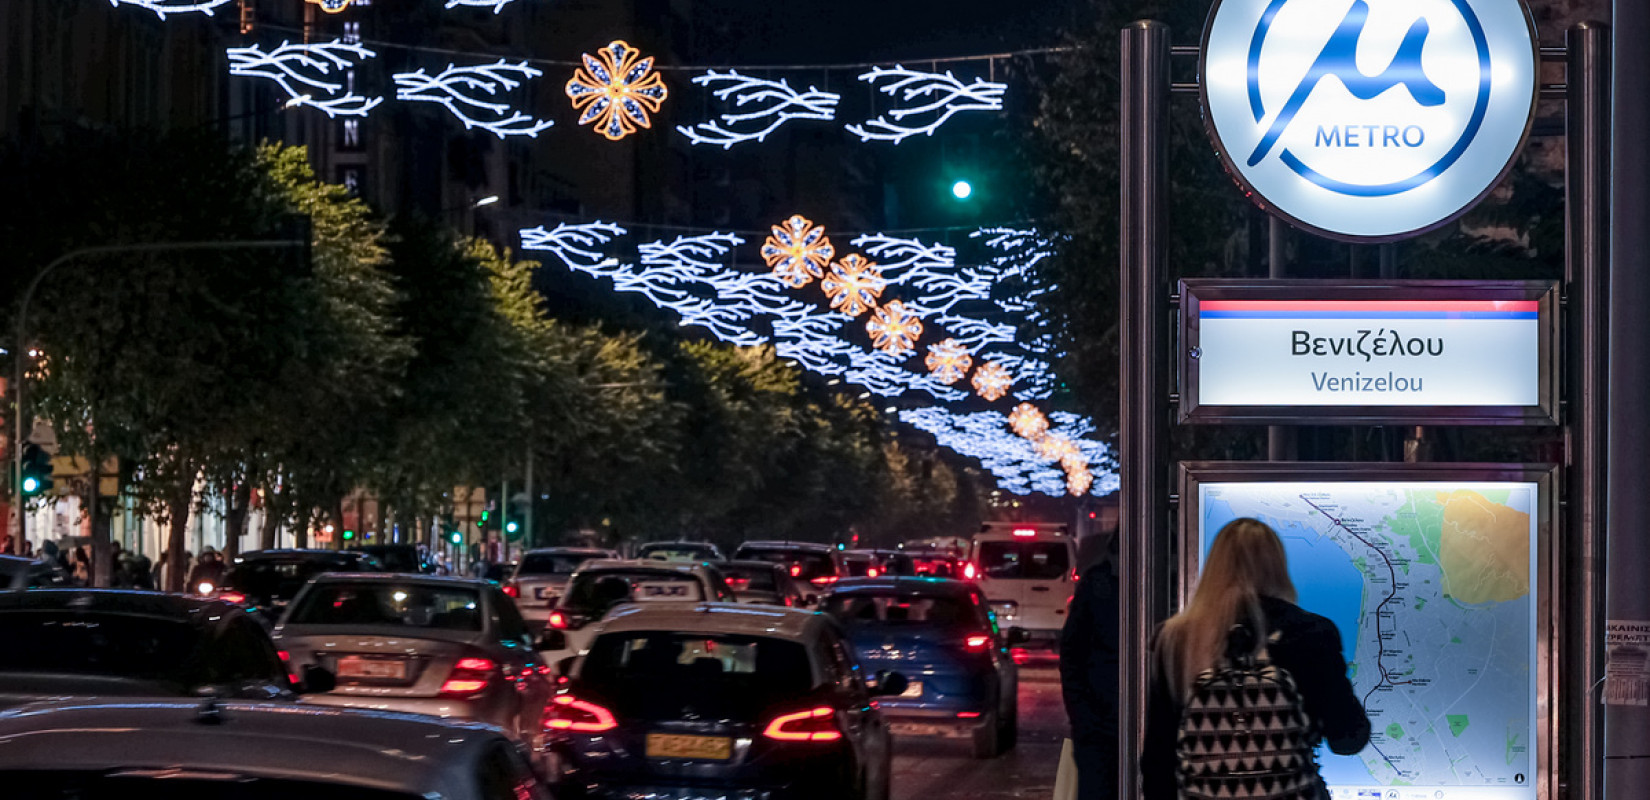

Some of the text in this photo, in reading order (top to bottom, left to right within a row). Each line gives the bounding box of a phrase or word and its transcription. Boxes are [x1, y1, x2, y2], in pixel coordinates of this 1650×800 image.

[1314, 126, 1425, 148] METRO
[1291, 329, 1444, 363] Βενιζέλου
[1311, 371, 1423, 391] Venizelou
